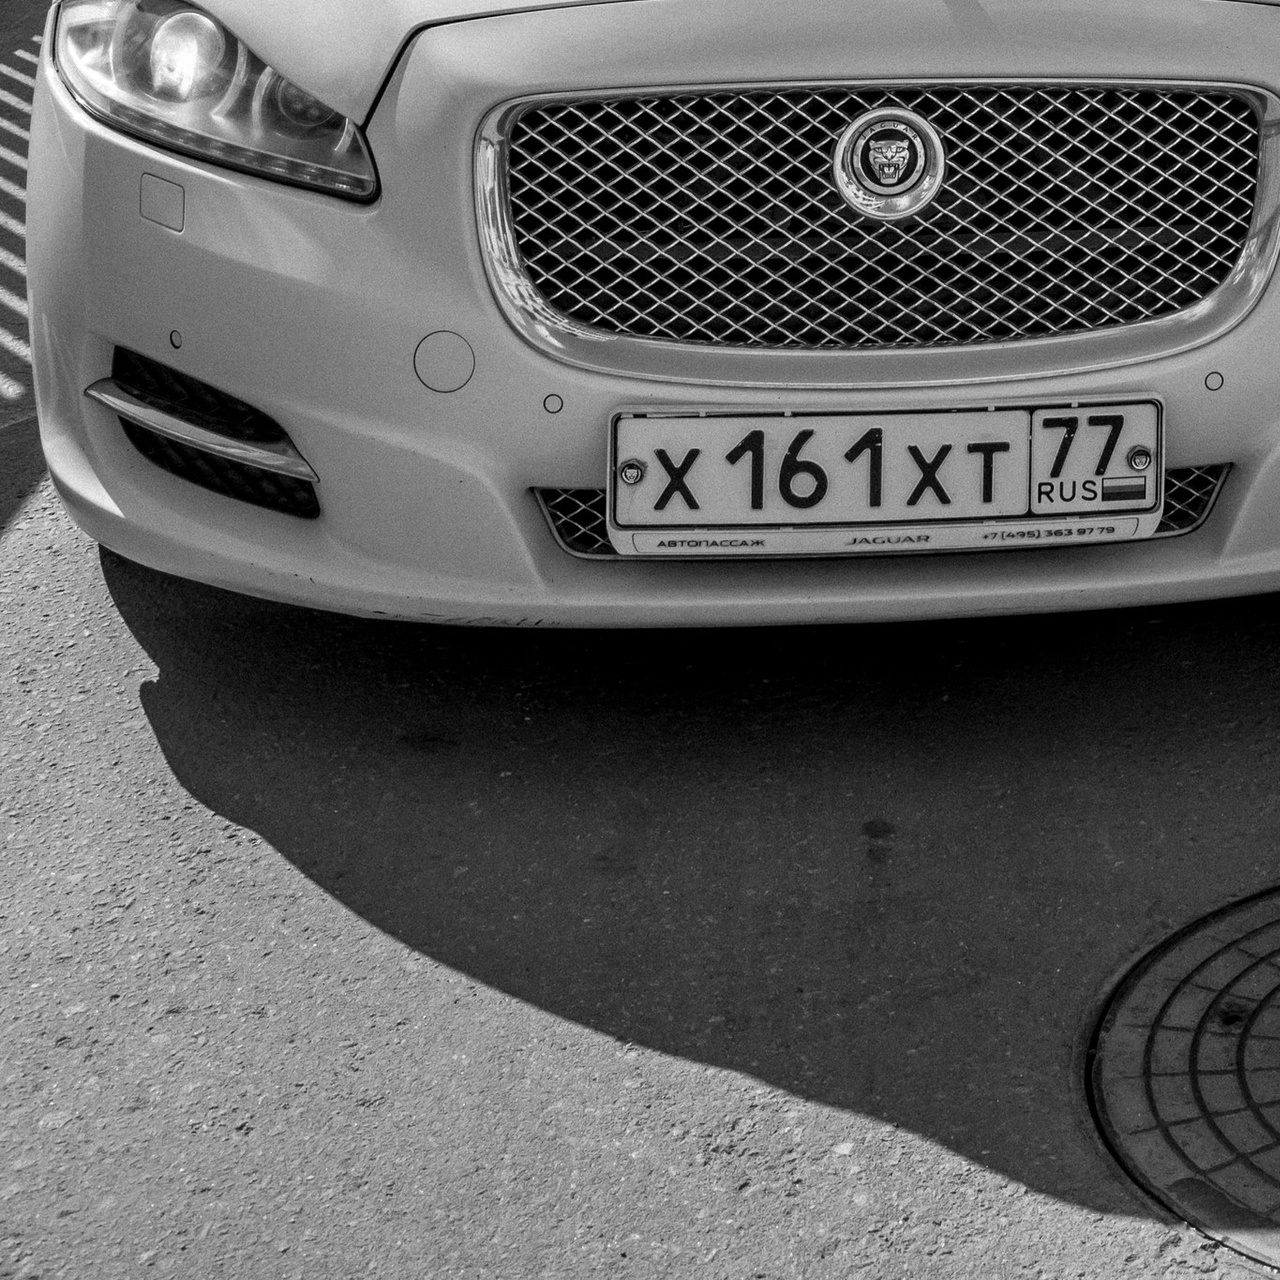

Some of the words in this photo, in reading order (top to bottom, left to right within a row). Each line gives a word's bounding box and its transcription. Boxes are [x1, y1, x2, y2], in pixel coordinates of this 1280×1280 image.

[862, 122, 919, 141] JAGUAR
[1042, 415, 1124, 477] 77
[1037, 480, 1098, 503] RUS
[1045, 528, 1073, 538] 363
[1098, 526, 1115, 535] 79
[656, 539, 765, 548] АВТОПАССАЖ
[846, 534, 931, 546] JAGUAR
